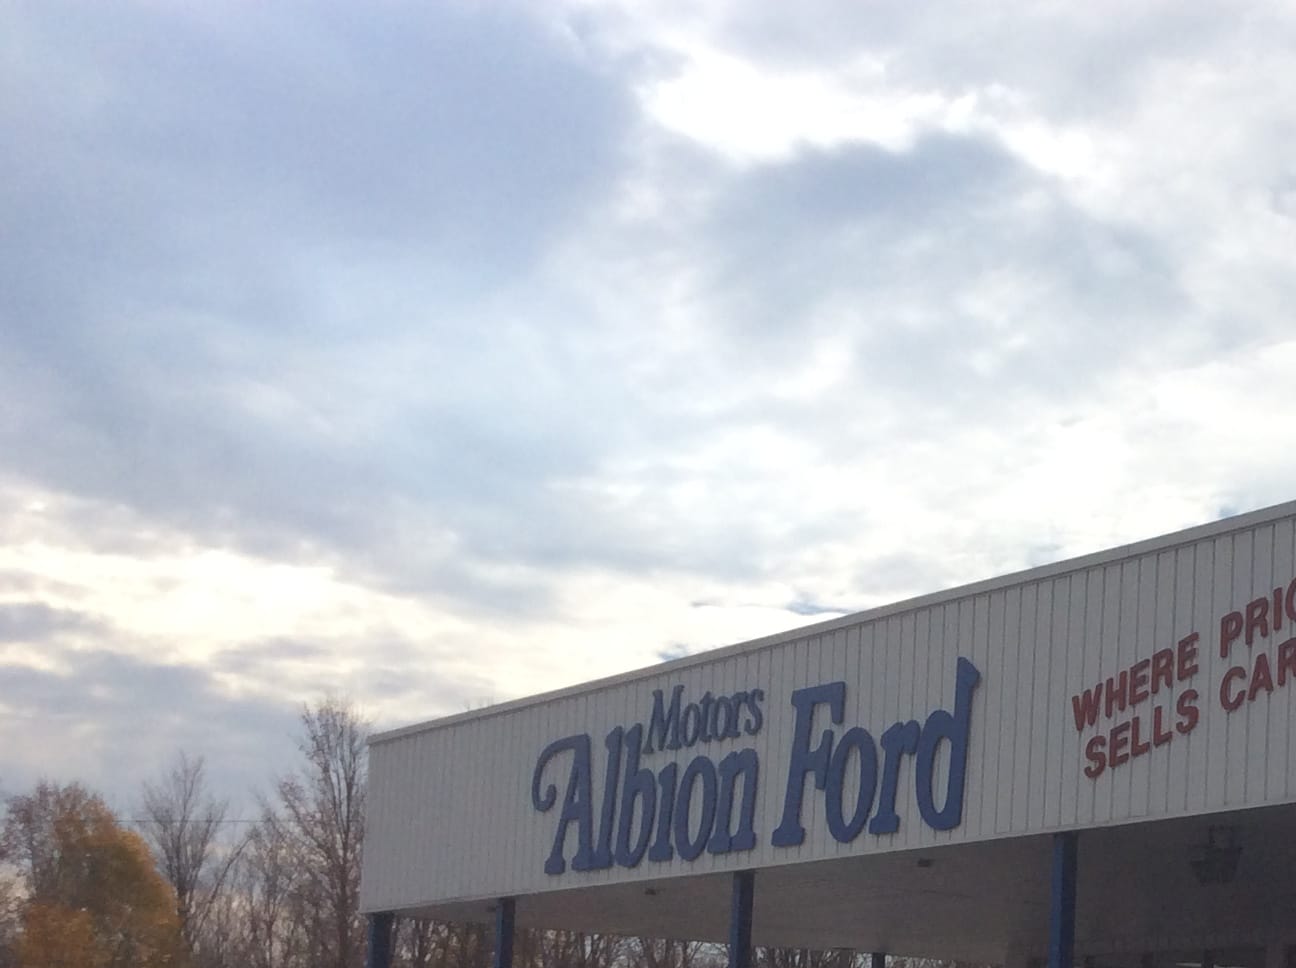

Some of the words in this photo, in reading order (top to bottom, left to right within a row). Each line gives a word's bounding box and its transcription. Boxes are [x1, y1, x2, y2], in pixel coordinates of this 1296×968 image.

[643, 684, 764, 754] Motors
[1071, 632, 1200, 732] WHERE
[531, 722, 760, 875] Albion
[771, 656, 981, 844] Ford
[1083, 688, 1200, 779] SELLS
